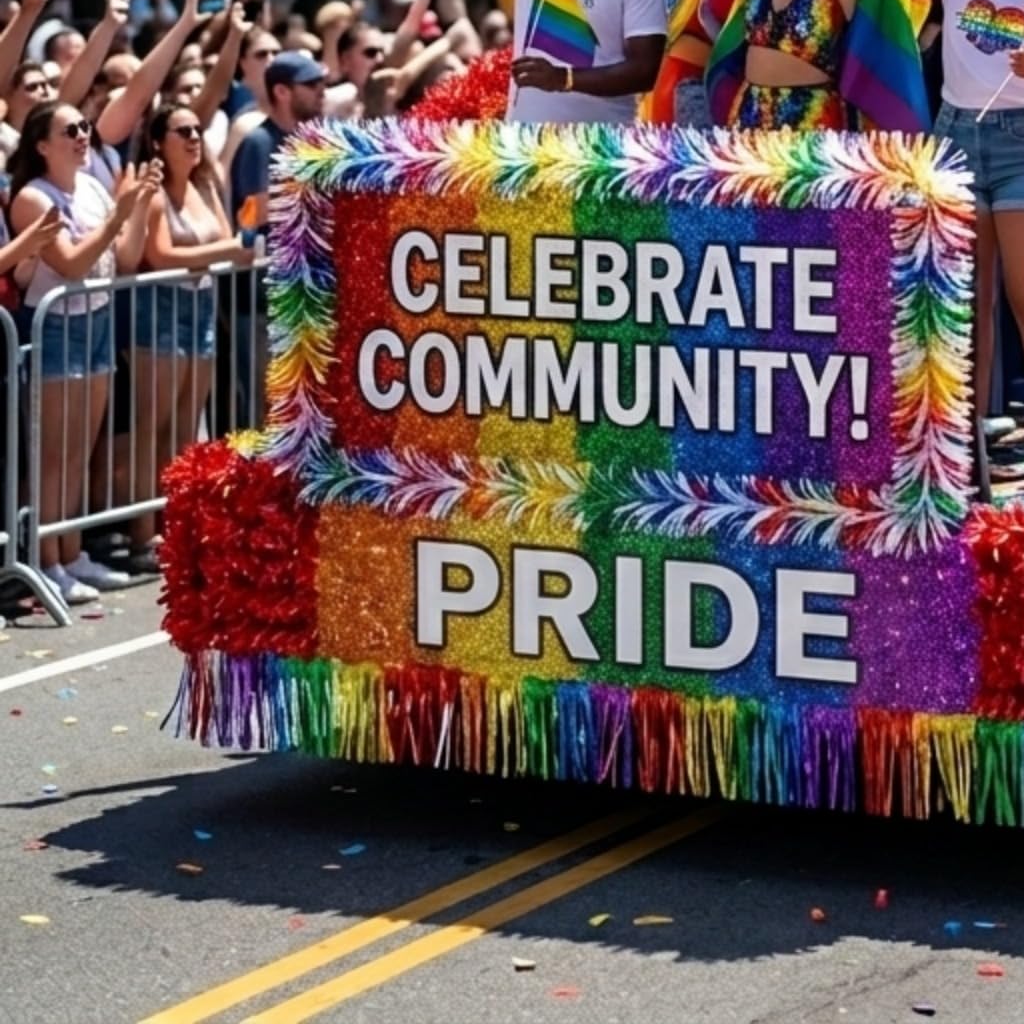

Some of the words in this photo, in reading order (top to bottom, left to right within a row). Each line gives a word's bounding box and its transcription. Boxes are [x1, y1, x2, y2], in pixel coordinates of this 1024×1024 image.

[391, 231, 838, 332] CELEBRATE
[358, 328, 869, 439] COMMUNITY!
[417, 542, 858, 683] PRIDE
